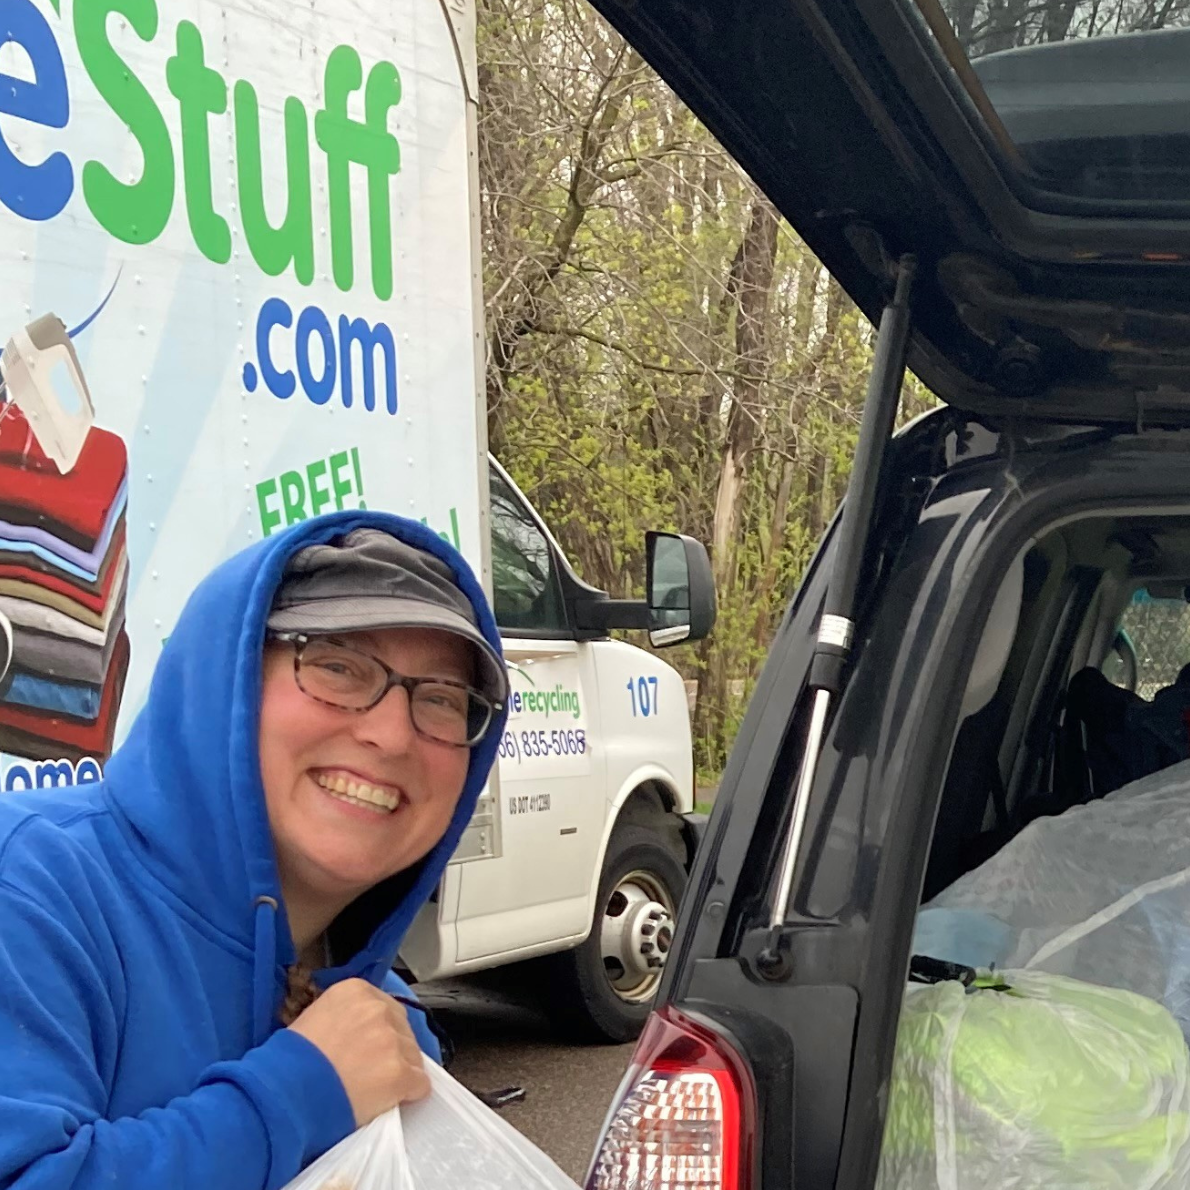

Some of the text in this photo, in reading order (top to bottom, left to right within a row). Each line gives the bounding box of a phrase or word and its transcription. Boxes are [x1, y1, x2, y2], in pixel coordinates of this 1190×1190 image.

[242, 297, 398, 415] .com
[256, 447, 367, 538] FREE!
[626, 676, 658, 717] 107
[521, 729, 586, 757] 835-5068
